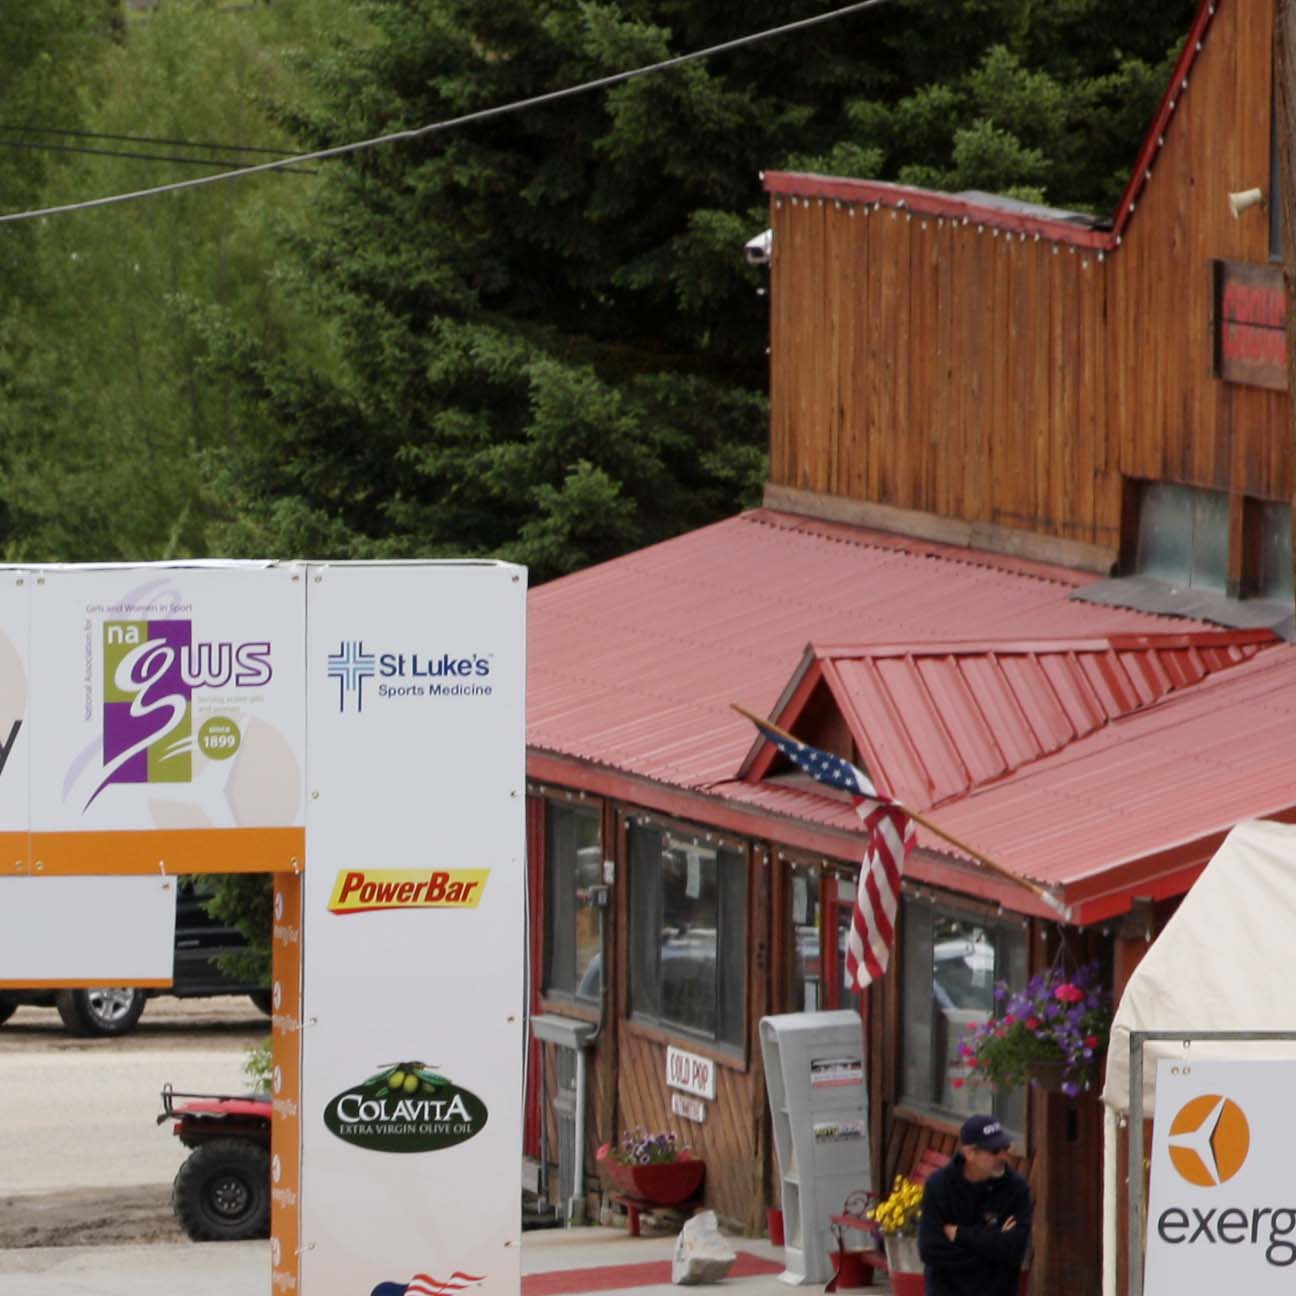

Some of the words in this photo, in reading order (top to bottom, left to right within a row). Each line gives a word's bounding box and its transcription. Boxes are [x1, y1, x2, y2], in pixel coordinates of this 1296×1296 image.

[379, 653, 407, 678] St
[378, 684, 426, 700] Sports
[429, 683, 493, 698] Medicine
[203, 736, 236, 748] 1899
[336, 870, 479, 905] PowerBar
[670, 1053, 690, 1084] COLD
[691, 1058, 710, 1090] POP
[336, 1093, 473, 1123] COLAVITA
[339, 1124, 374, 1136] EXTRA
[376, 1124, 416, 1135] VIRGIN
[419, 1123, 451, 1134] OLIVE
[453, 1122, 472, 1134] OIL
